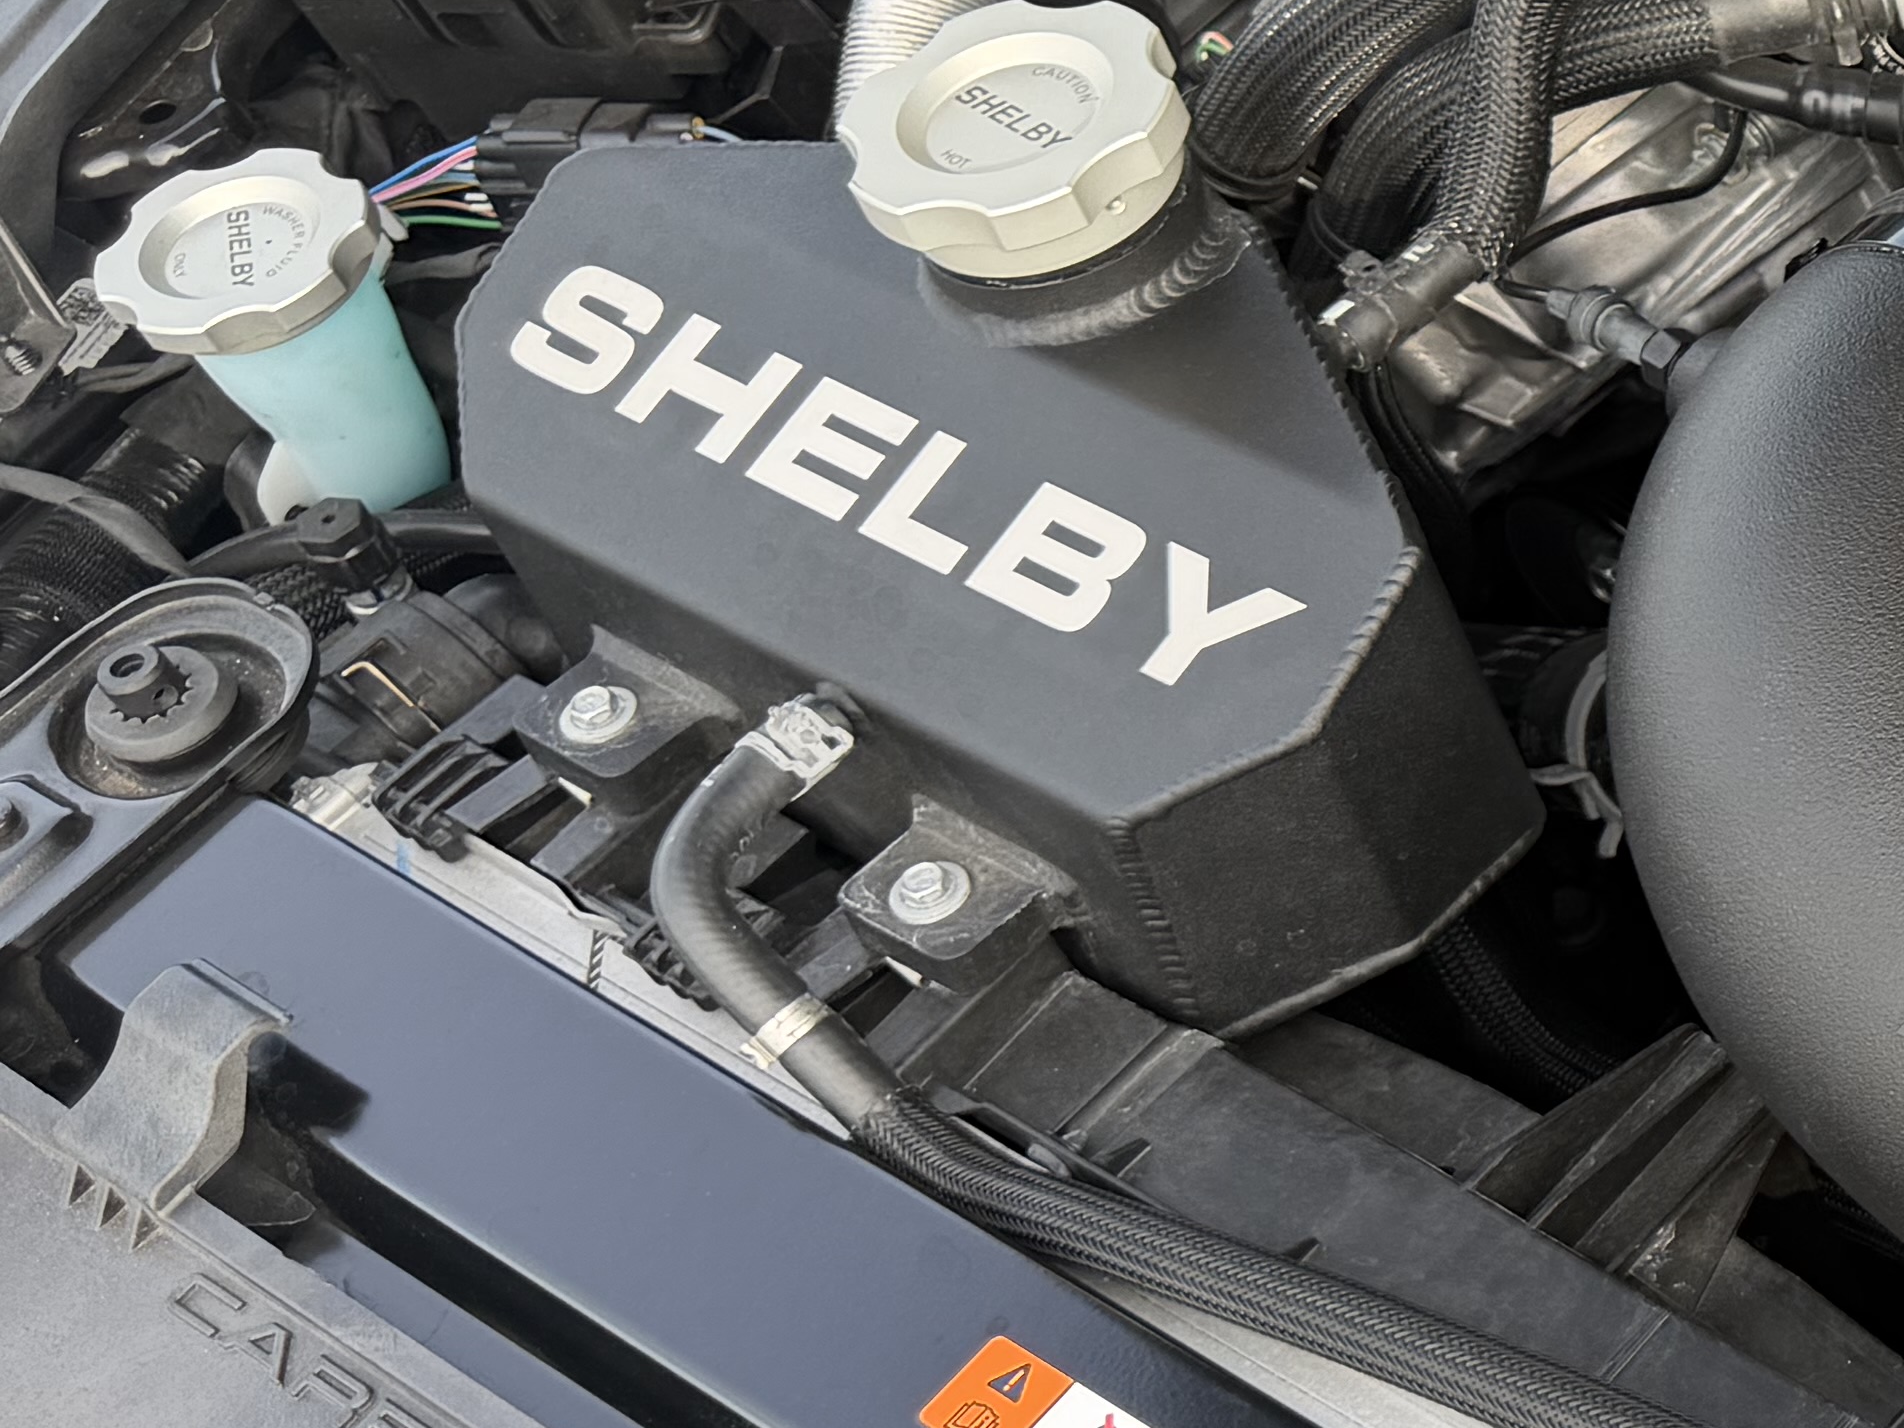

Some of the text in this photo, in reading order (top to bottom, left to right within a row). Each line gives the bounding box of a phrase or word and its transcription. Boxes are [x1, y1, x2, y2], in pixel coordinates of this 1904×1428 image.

[955, 85, 1074, 149] SHELBY
[1031, 66, 1099, 104] CAUTION
[940, 149, 972, 169] HOT
[173, 252, 187, 279] ONLY
[226, 208, 256, 287] SHELBY
[261, 204, 307, 278] WASHER FLUID
[508, 262, 1307, 688] SHELBY
